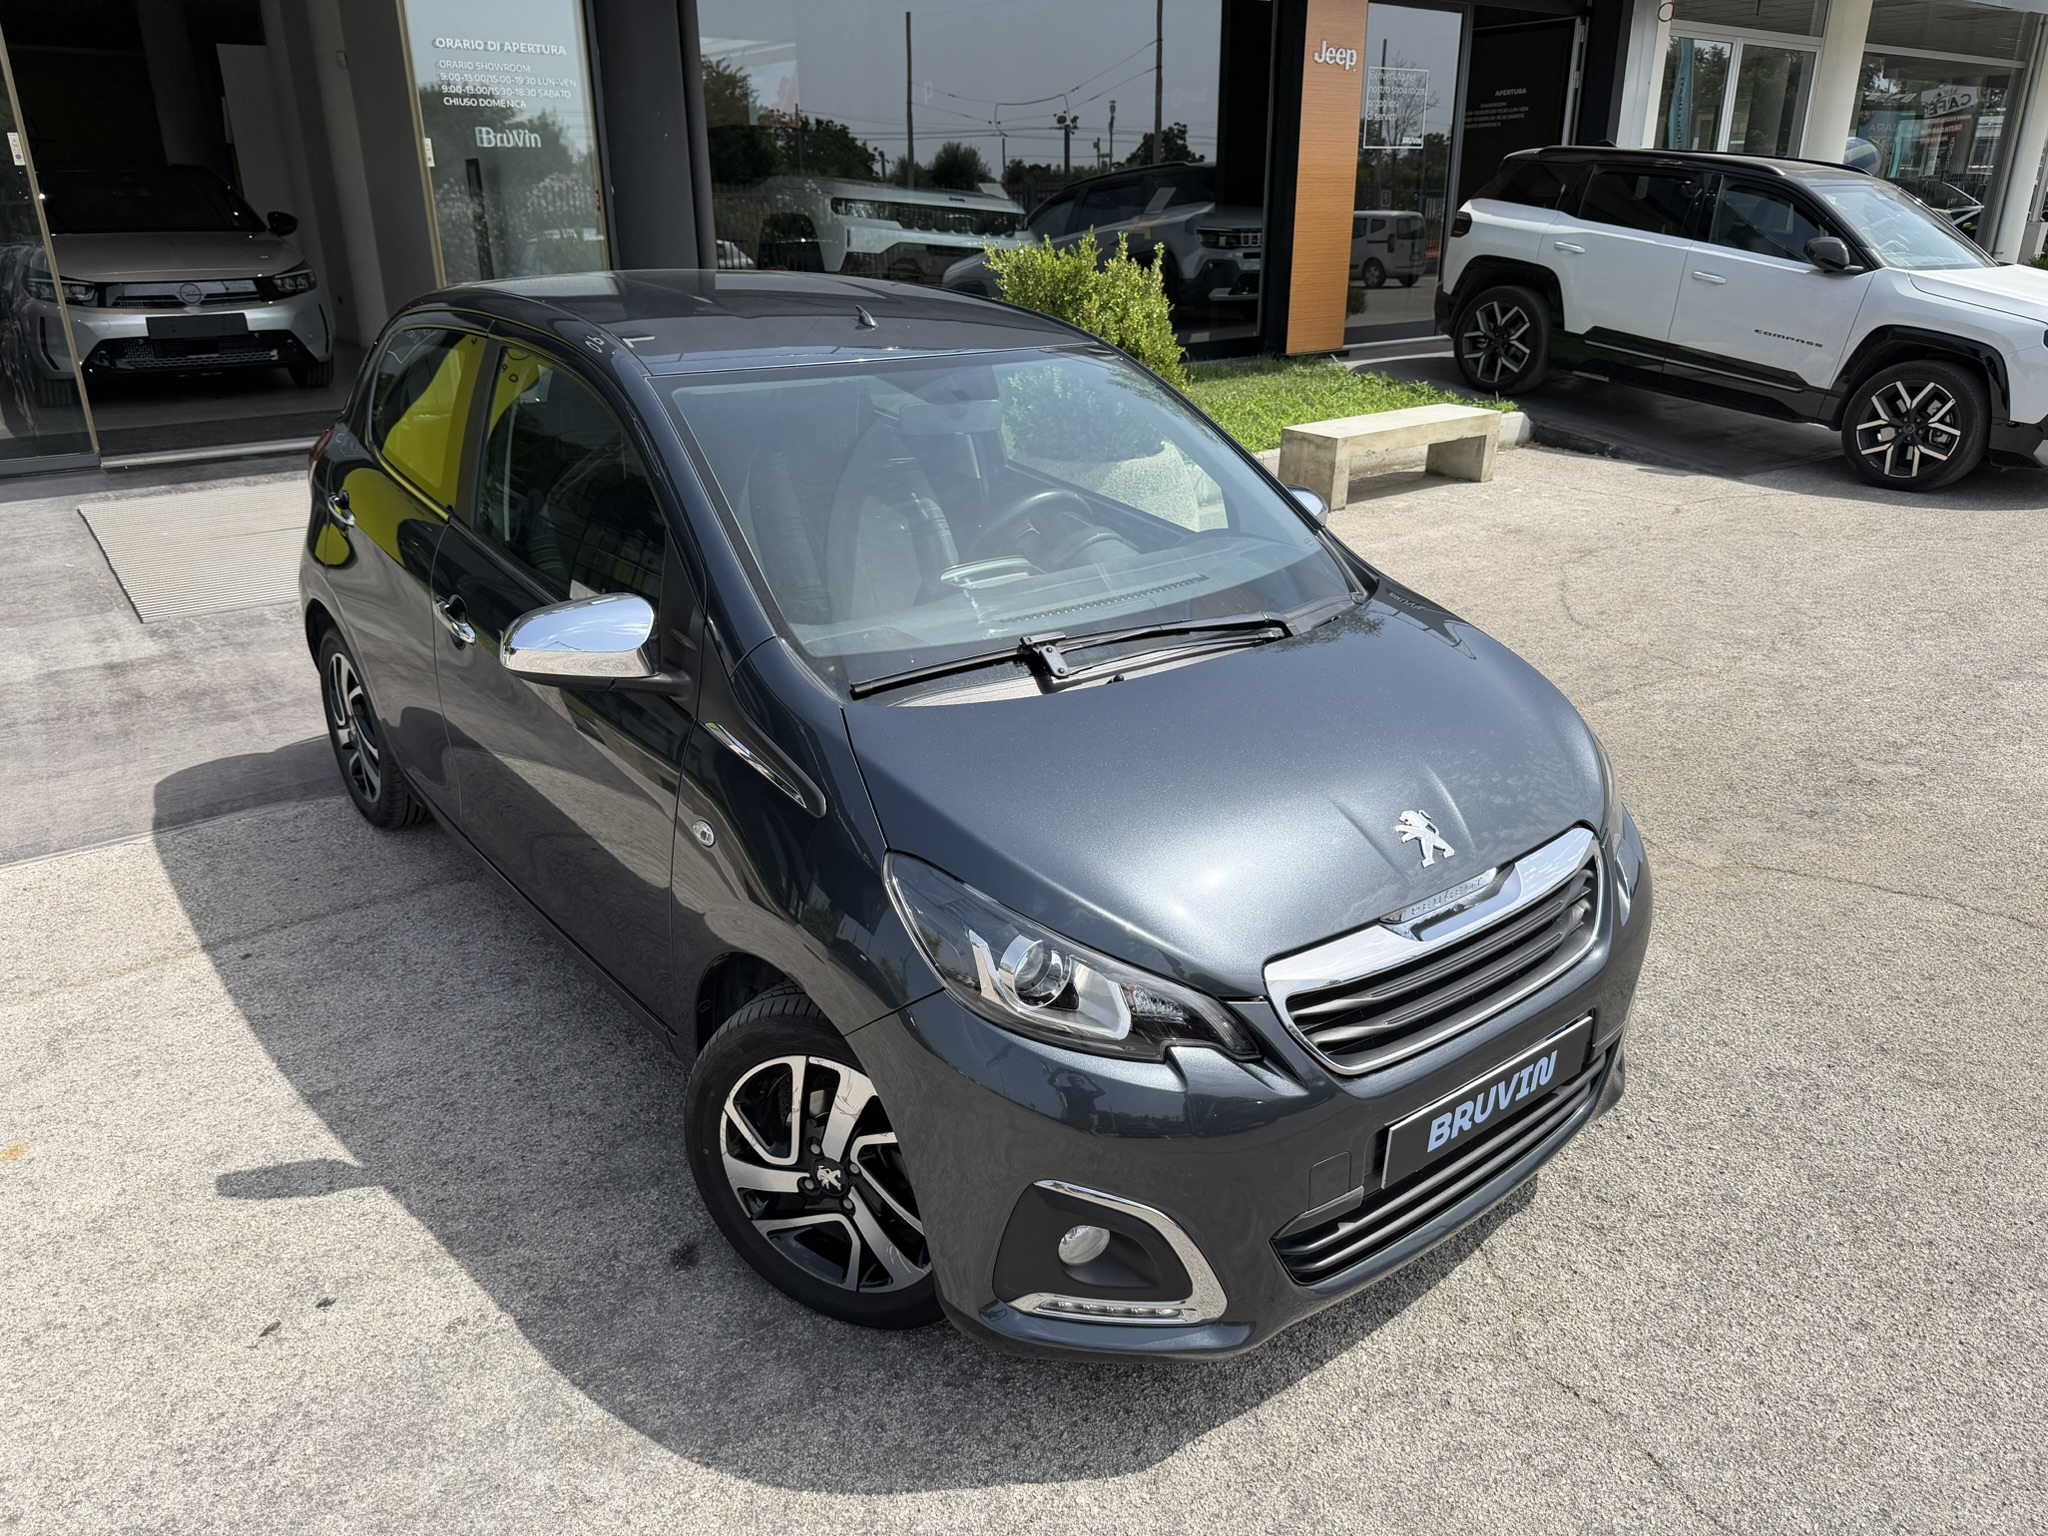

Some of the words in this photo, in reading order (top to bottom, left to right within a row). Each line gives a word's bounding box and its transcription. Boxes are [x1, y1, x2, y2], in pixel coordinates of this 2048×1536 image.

[435, 37, 484, 51] ORARIO
[487, 40, 501, 52] DI
[503, 42, 567, 56] APERTURA
[1313, 40, 1357, 70] Jeep
[439, 60, 474, 71] ORARIO
[475, 62, 531, 73] SHOWROOM
[443, 97, 478, 107] CHIUSO
[537, 89, 572, 99] SABATO
[1753, 328, 1824, 348] COMPASS
[1411, 876, 1483, 915] PEUGEOT
[1426, 1050, 1559, 1153] BRUVIN
